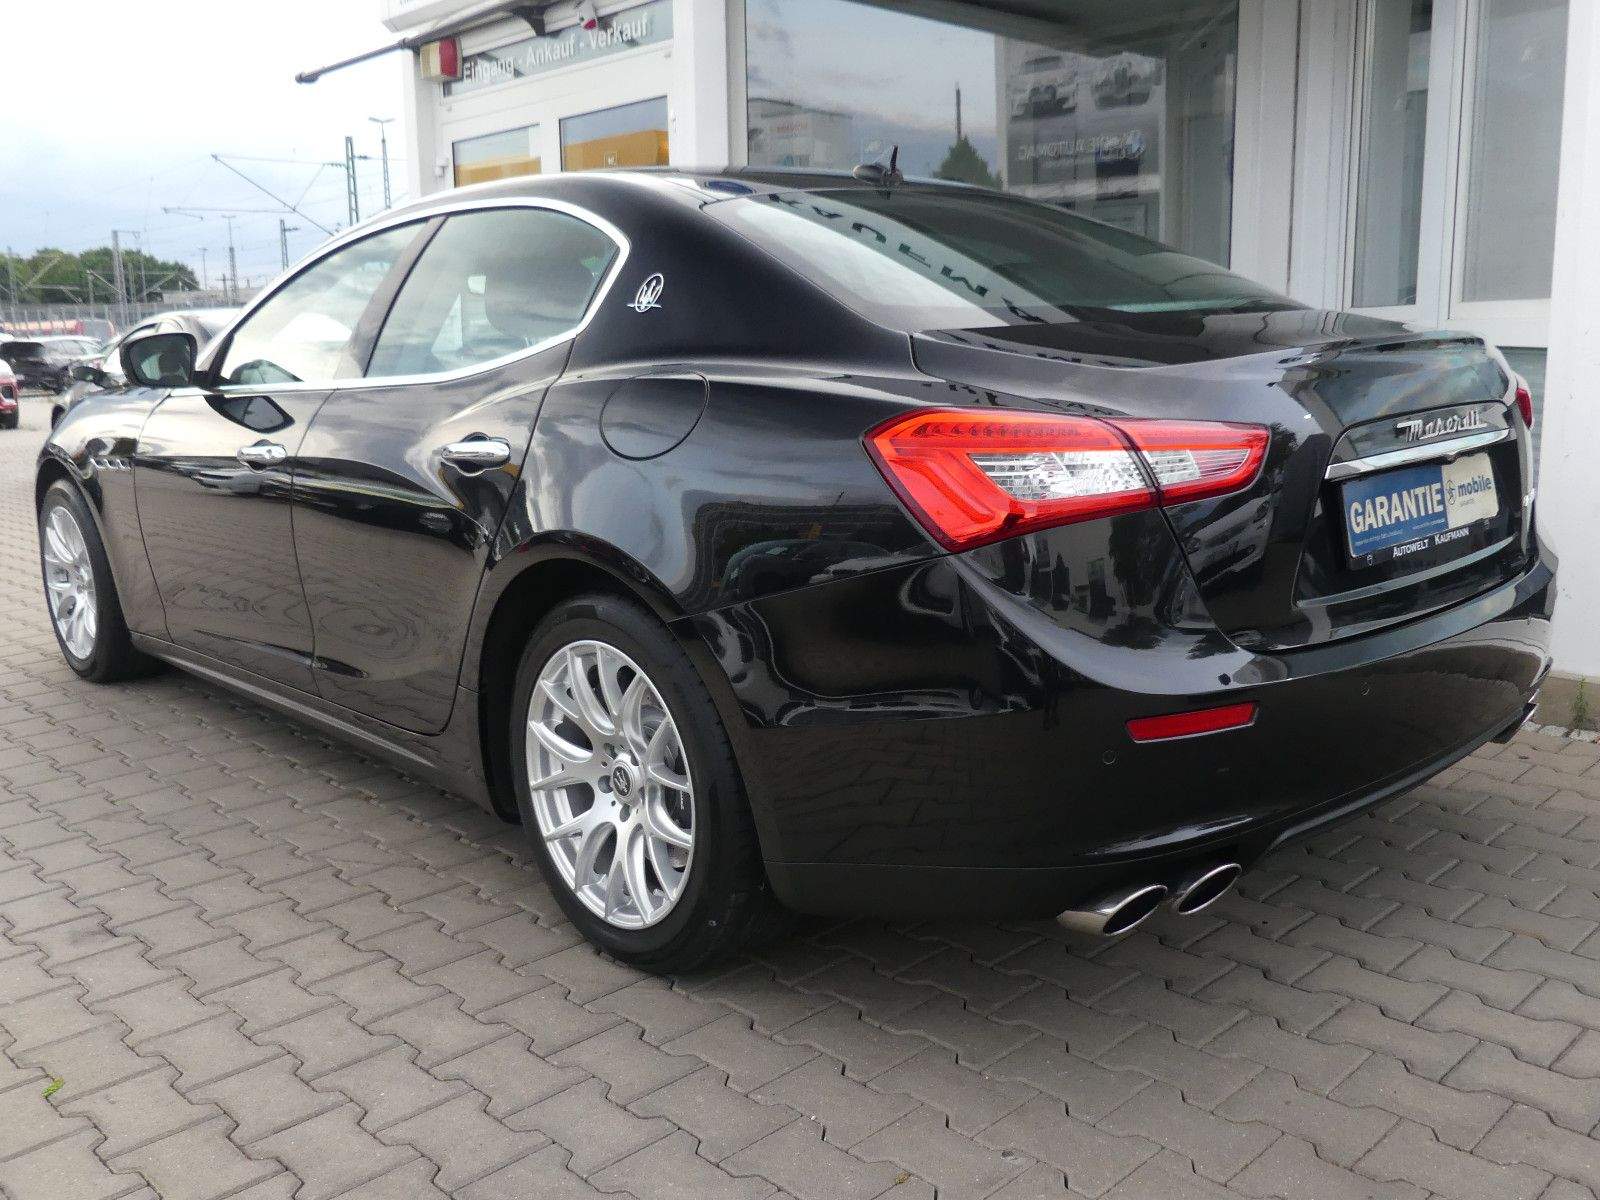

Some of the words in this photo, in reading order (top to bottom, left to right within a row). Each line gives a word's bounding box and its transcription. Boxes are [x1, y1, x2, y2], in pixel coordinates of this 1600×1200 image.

[462, 56, 514, 83] Eingang
[526, 36, 576, 66] Ankauf
[589, 13, 649, 48] Verkauf
[1396, 410, 1487, 441] Maserati
[1457, 475, 1492, 497] mobile
[1351, 483, 1444, 534] GARANTIE
